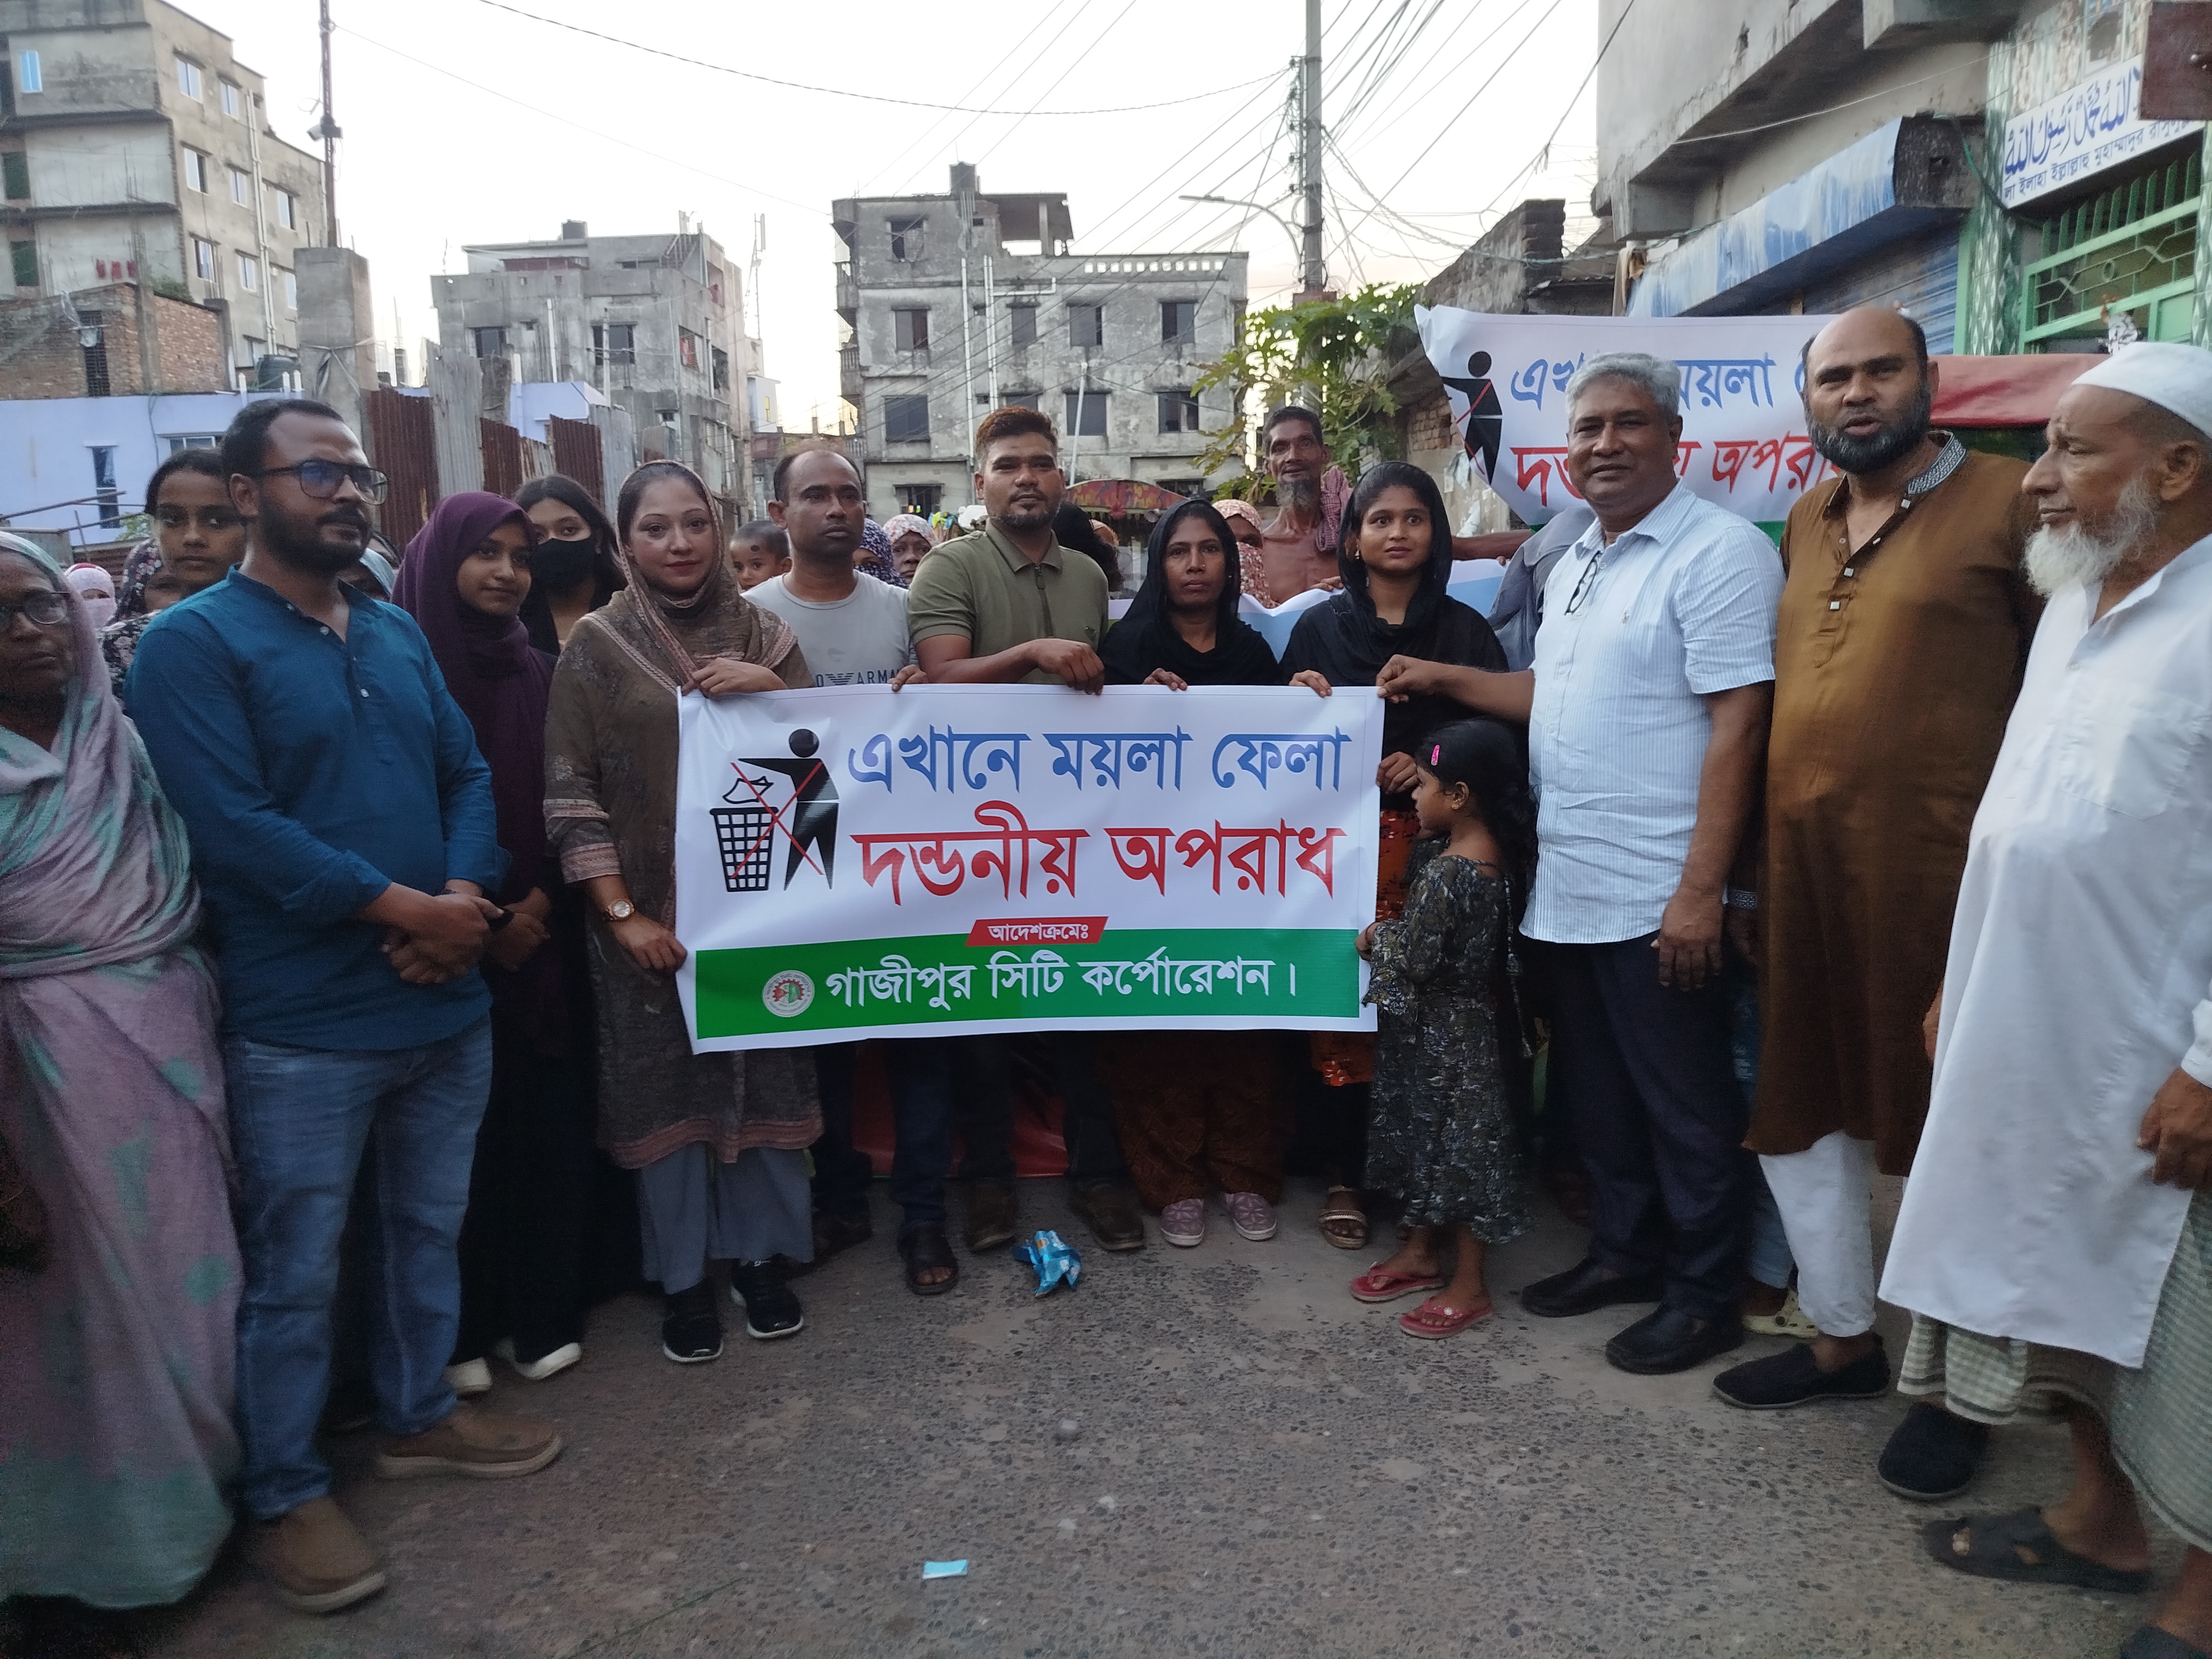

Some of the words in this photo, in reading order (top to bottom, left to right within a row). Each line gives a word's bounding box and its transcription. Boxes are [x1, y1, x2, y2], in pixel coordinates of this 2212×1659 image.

[848, 724, 1032, 794] এখানে
[1042, 724, 1194, 792] ময়লা
[1212, 725, 1353, 792] ফেলা
[1103, 817, 1348, 900] অপরাধ
[826, 954, 979, 1011] গাজীপুর
[984, 949, 1071, 998] সিটি
